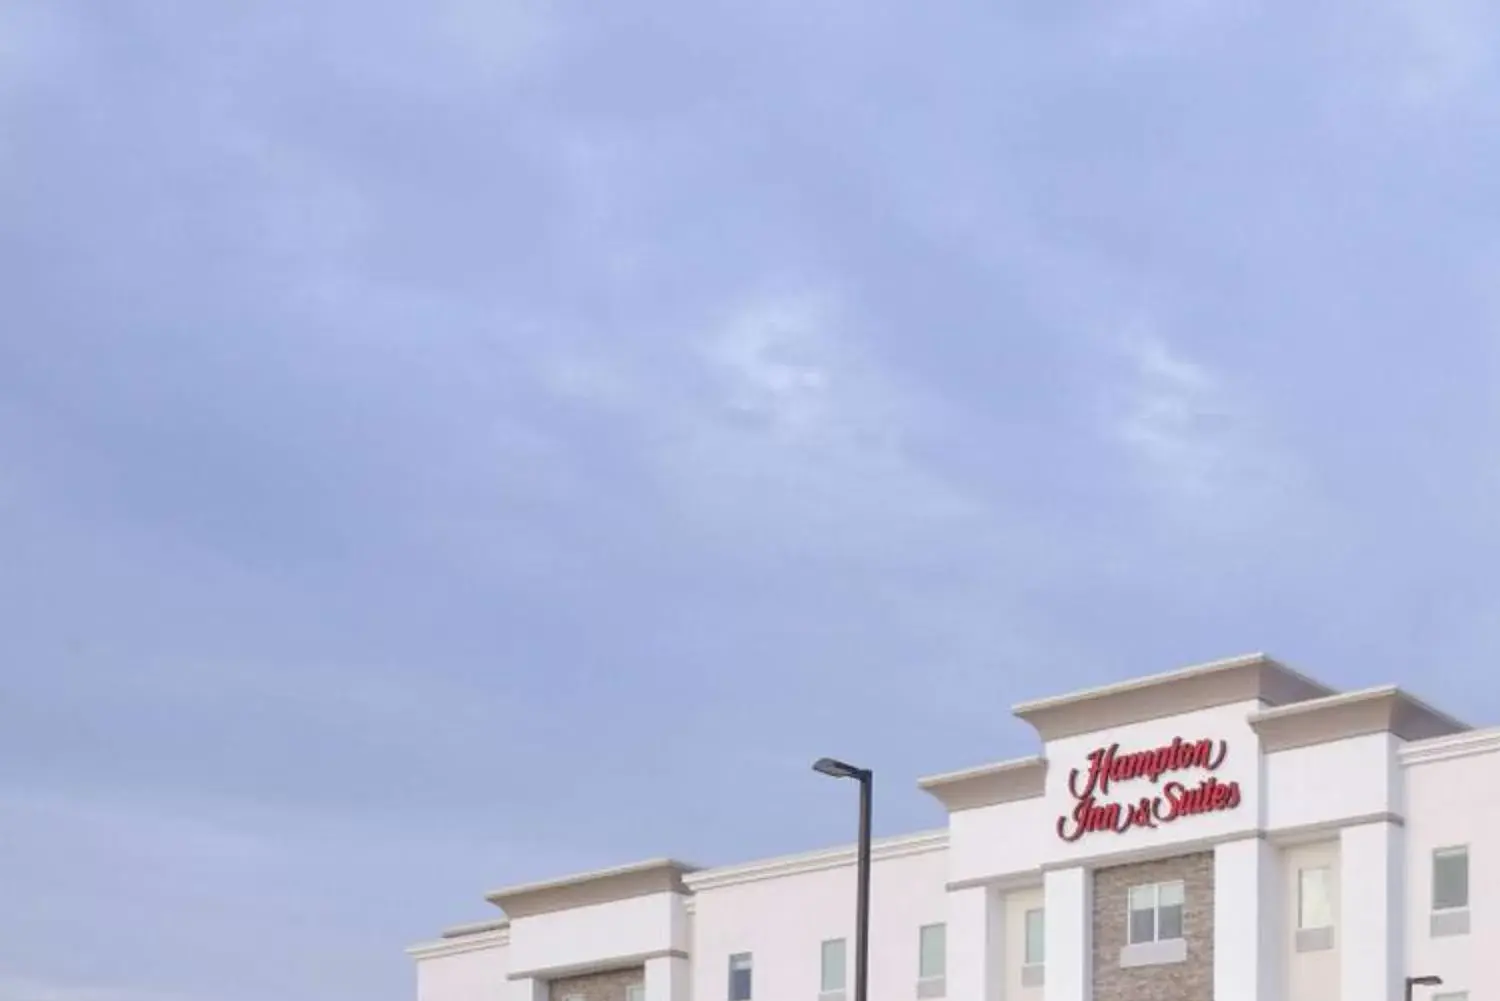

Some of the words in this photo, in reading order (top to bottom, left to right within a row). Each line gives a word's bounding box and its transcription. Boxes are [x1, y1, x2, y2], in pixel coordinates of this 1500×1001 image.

[1069, 736, 1227, 799] Hampton
[1057, 795, 1133, 842] Inn
[1133, 797, 1157, 828] &
[1152, 776, 1241, 822] Suites
